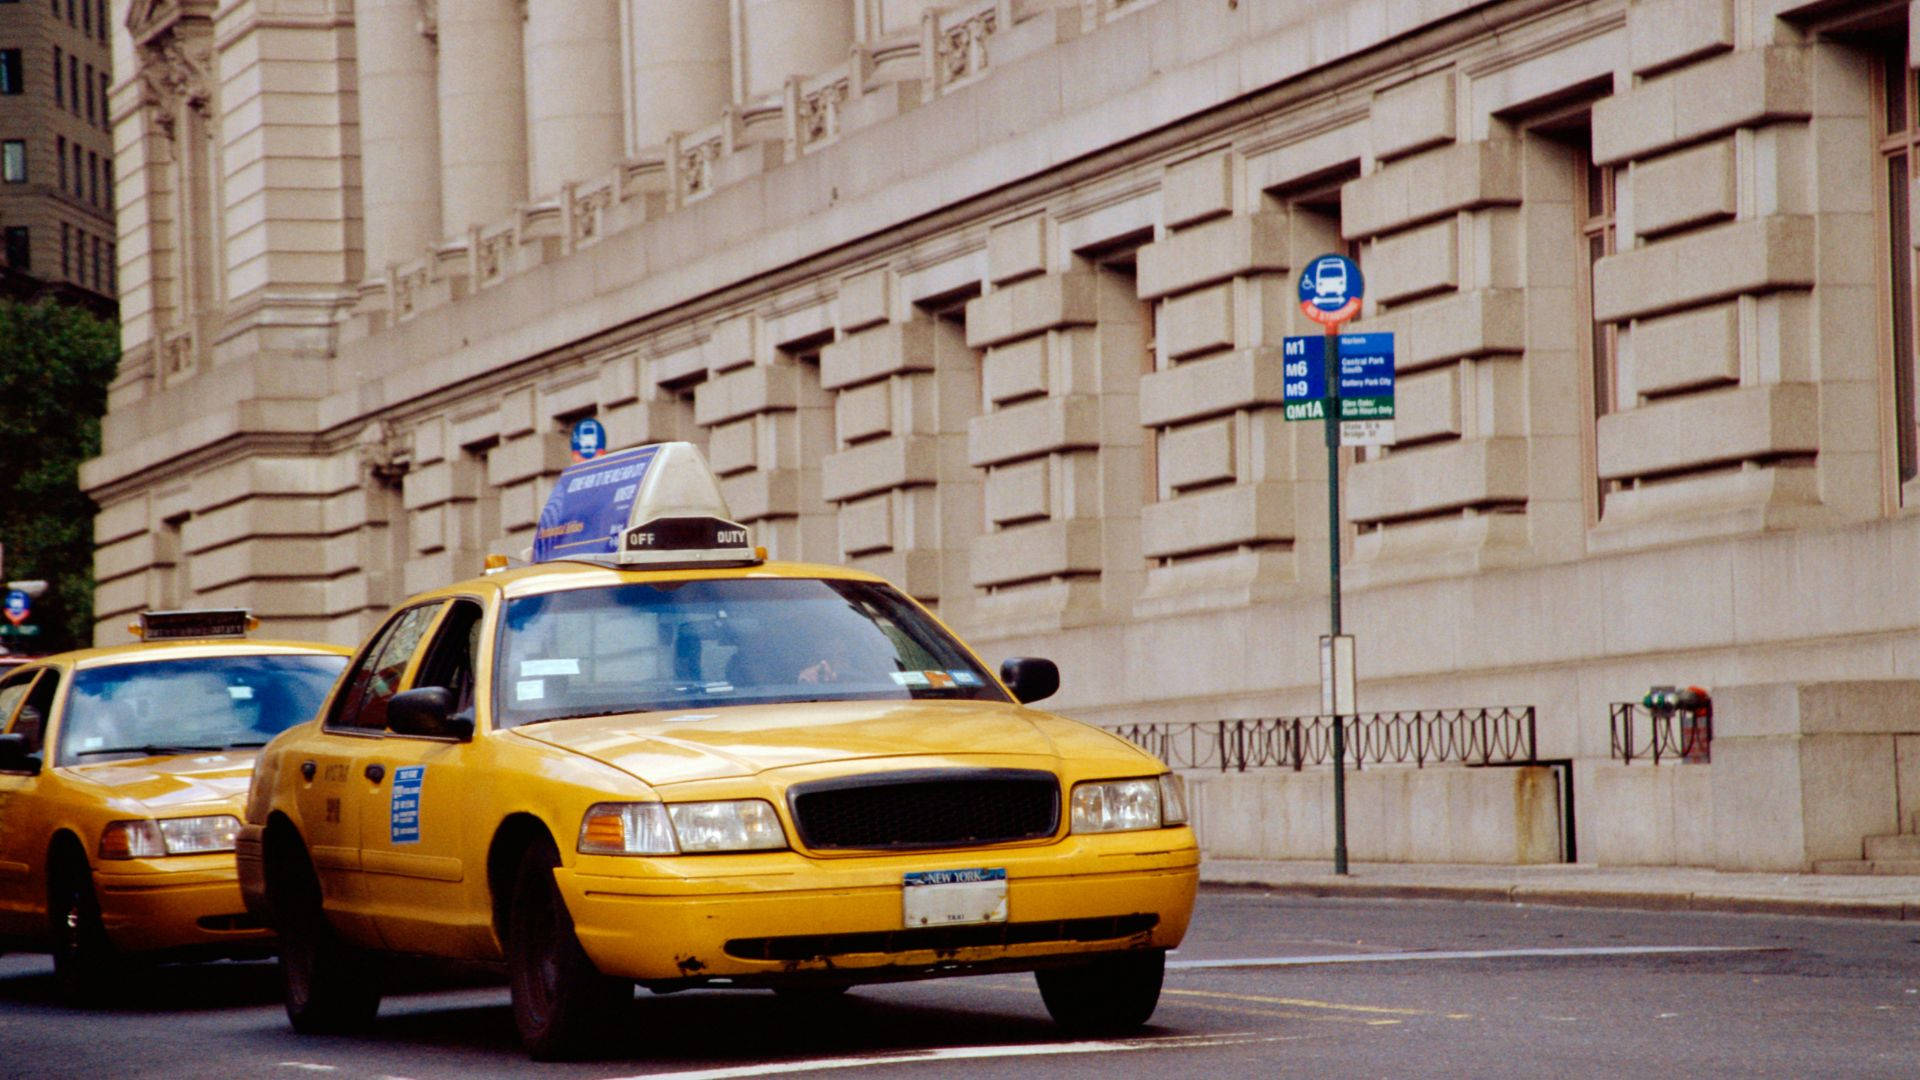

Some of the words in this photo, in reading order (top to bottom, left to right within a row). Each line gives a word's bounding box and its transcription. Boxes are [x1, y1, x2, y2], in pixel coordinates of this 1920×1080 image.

[1286, 338, 1304, 355] M1
[1286, 360, 1307, 377] M6
[1342, 357, 1367, 366] Central
[1368, 356, 1384, 365] Park
[1286, 380, 1308, 397] M9
[1364, 378, 1378, 387] Park
[1379, 377, 1391, 387] City
[1286, 400, 1324, 419] QM1A
[630, 533, 655, 545] OFF
[717, 530, 745, 543] DUTY
[928, 873, 952, 884] NEW
[954, 871, 981, 883] YORK
